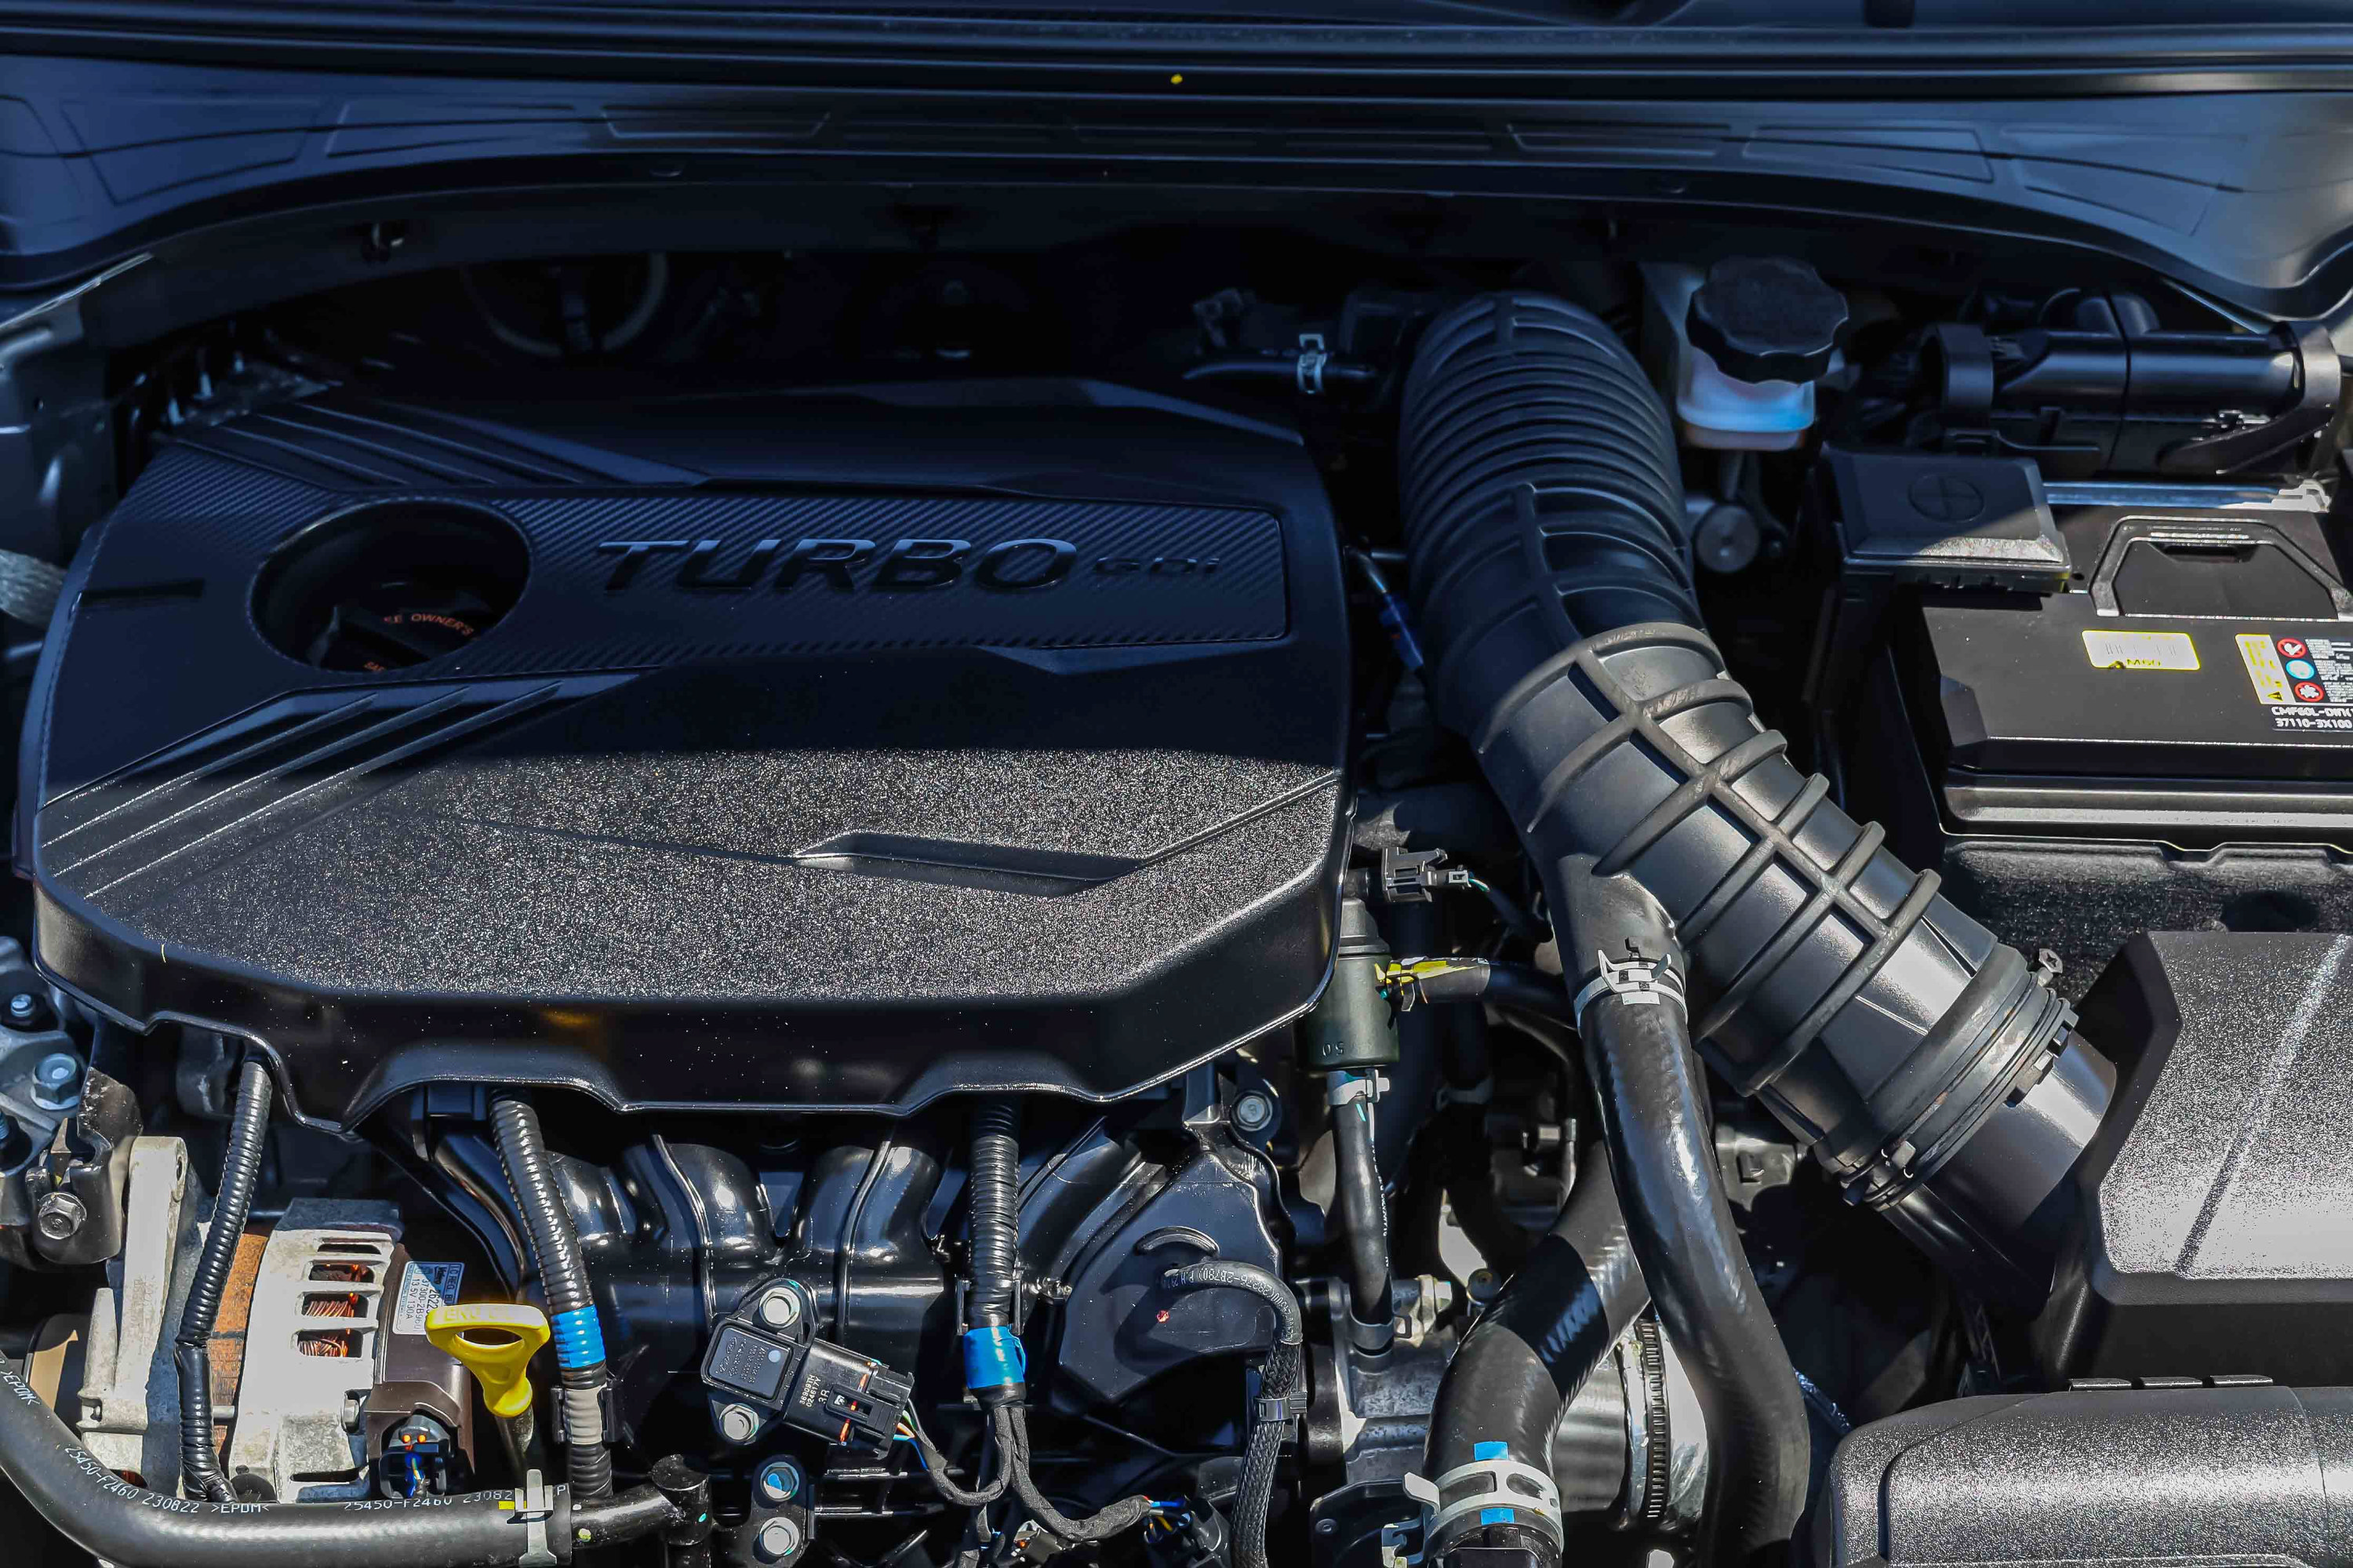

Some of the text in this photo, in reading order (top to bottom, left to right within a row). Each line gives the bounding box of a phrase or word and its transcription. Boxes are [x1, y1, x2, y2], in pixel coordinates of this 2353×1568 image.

[598, 537, 1078, 591] TURBO
[2275, 717, 2353, 729] 37110-3X100
[409, 1279, 420, 1299] 13.5V
[406, 1301, 416, 1320] 130A
[64, 1446, 140, 1500] 25450-F2460
